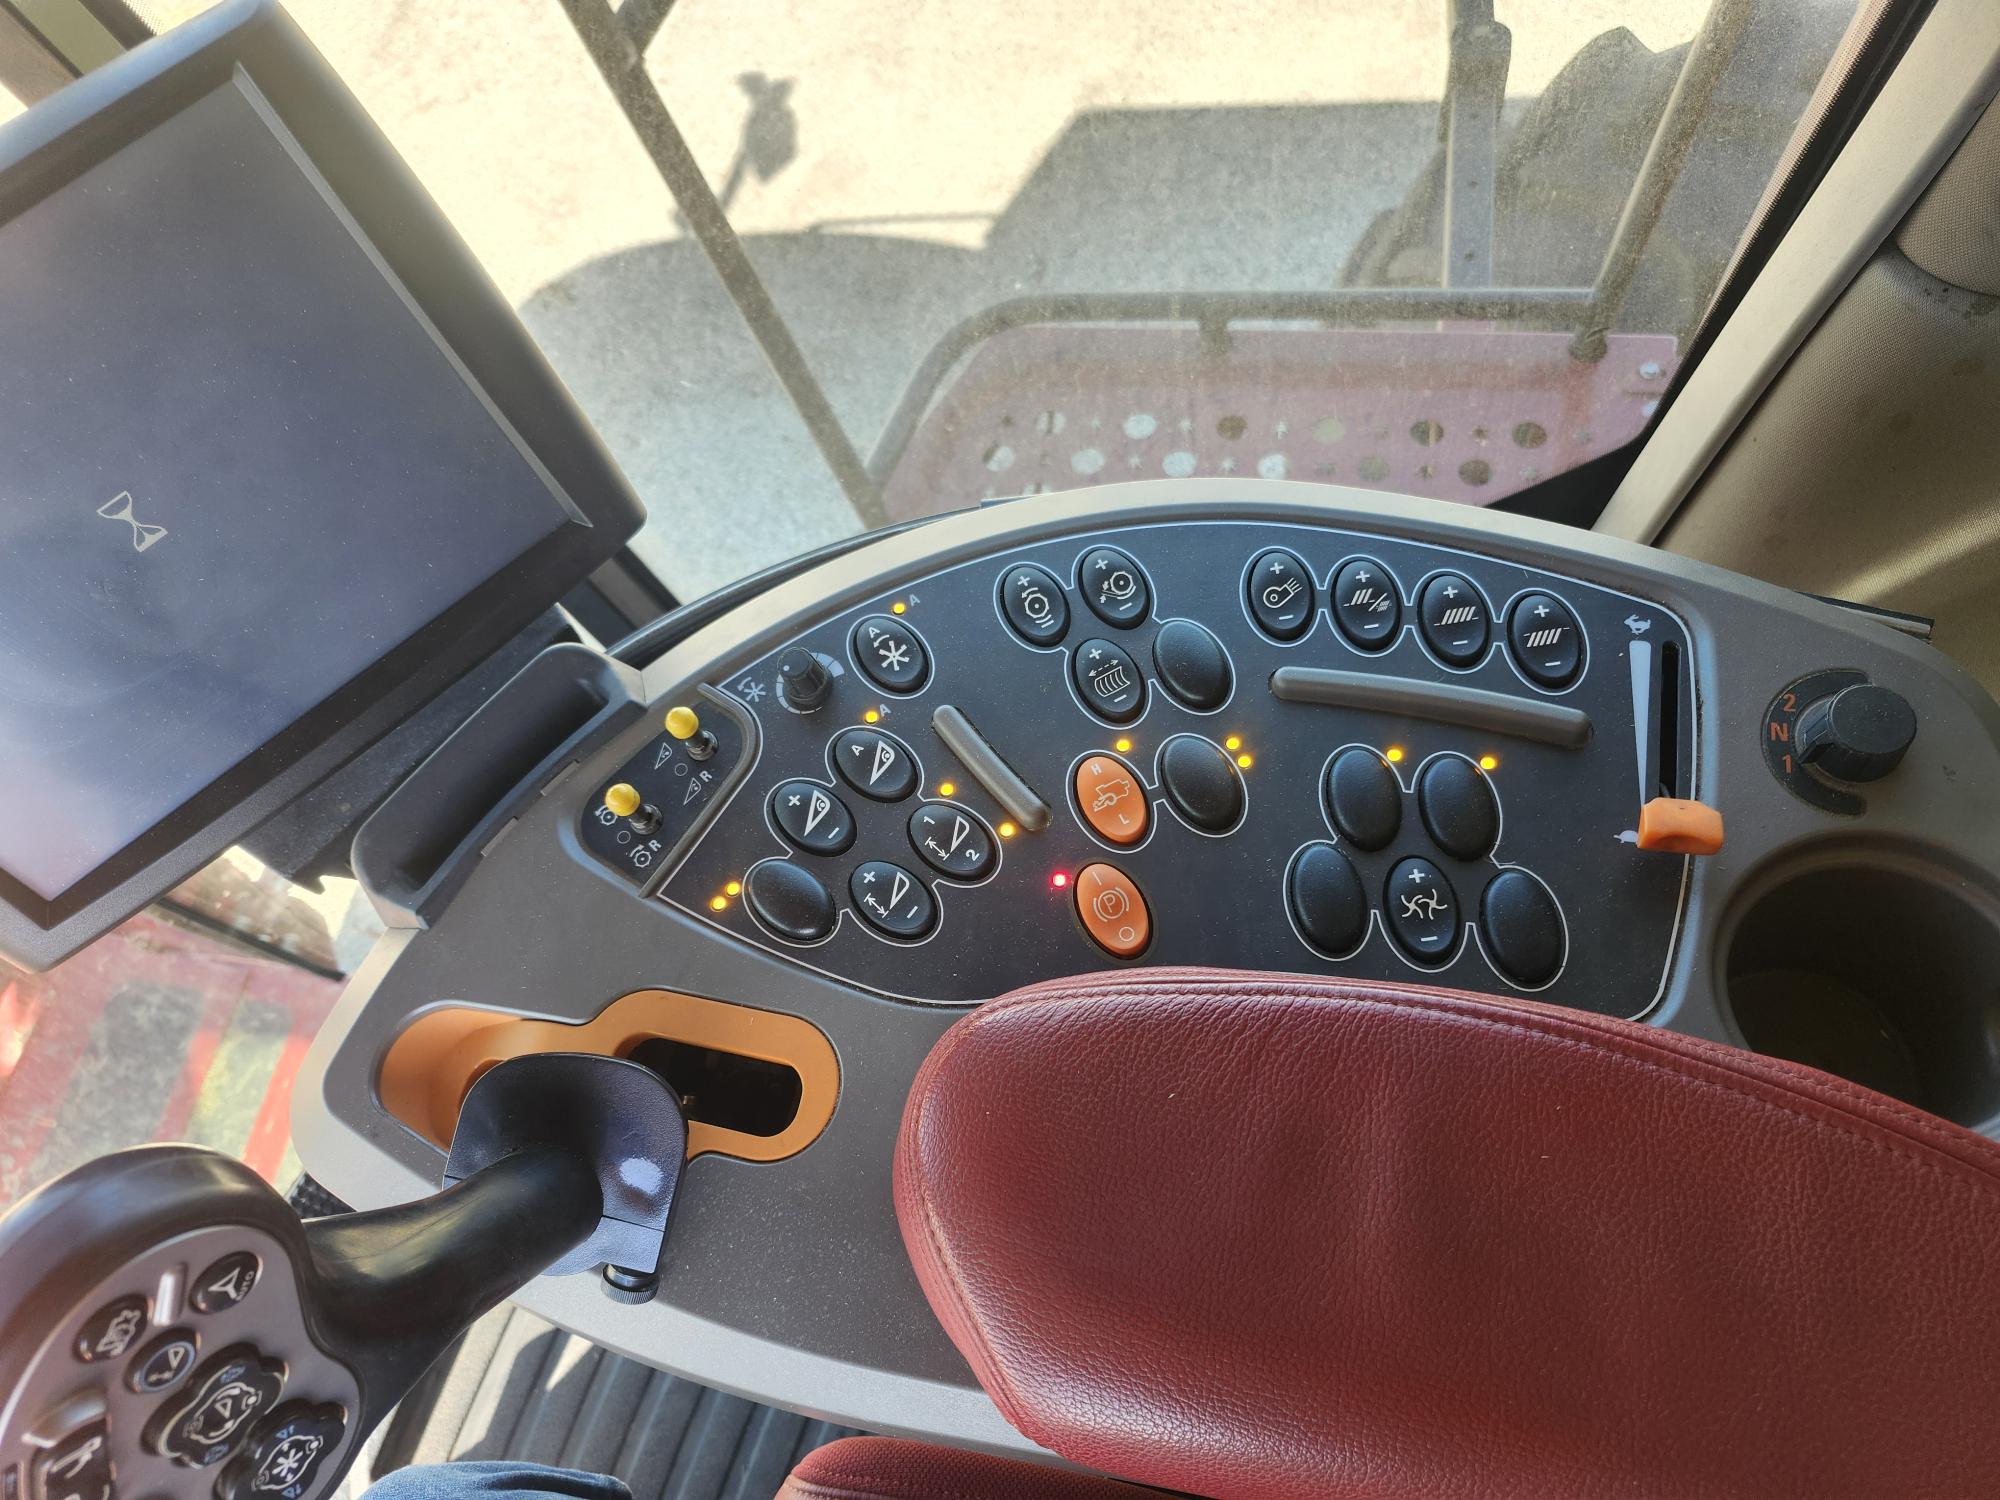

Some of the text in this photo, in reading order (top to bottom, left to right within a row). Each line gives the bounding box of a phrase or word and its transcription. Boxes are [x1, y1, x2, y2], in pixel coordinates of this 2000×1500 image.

[909, 594, 920, 607] A
[868, 626, 880, 639] A
[1783, 693, 1796, 713] 2
[880, 703, 892, 717] A
[1770, 722, 1789, 742] N
[851, 744, 864, 757] A
[1091, 763, 1102, 776] H
[1782, 754, 1793, 774] 1
[699, 770, 713, 783] R
[923, 815, 935, 825] 1
[648, 839, 662, 852] R
[965, 849, 980, 862] 2
[1103, 894, 1116, 913] P
